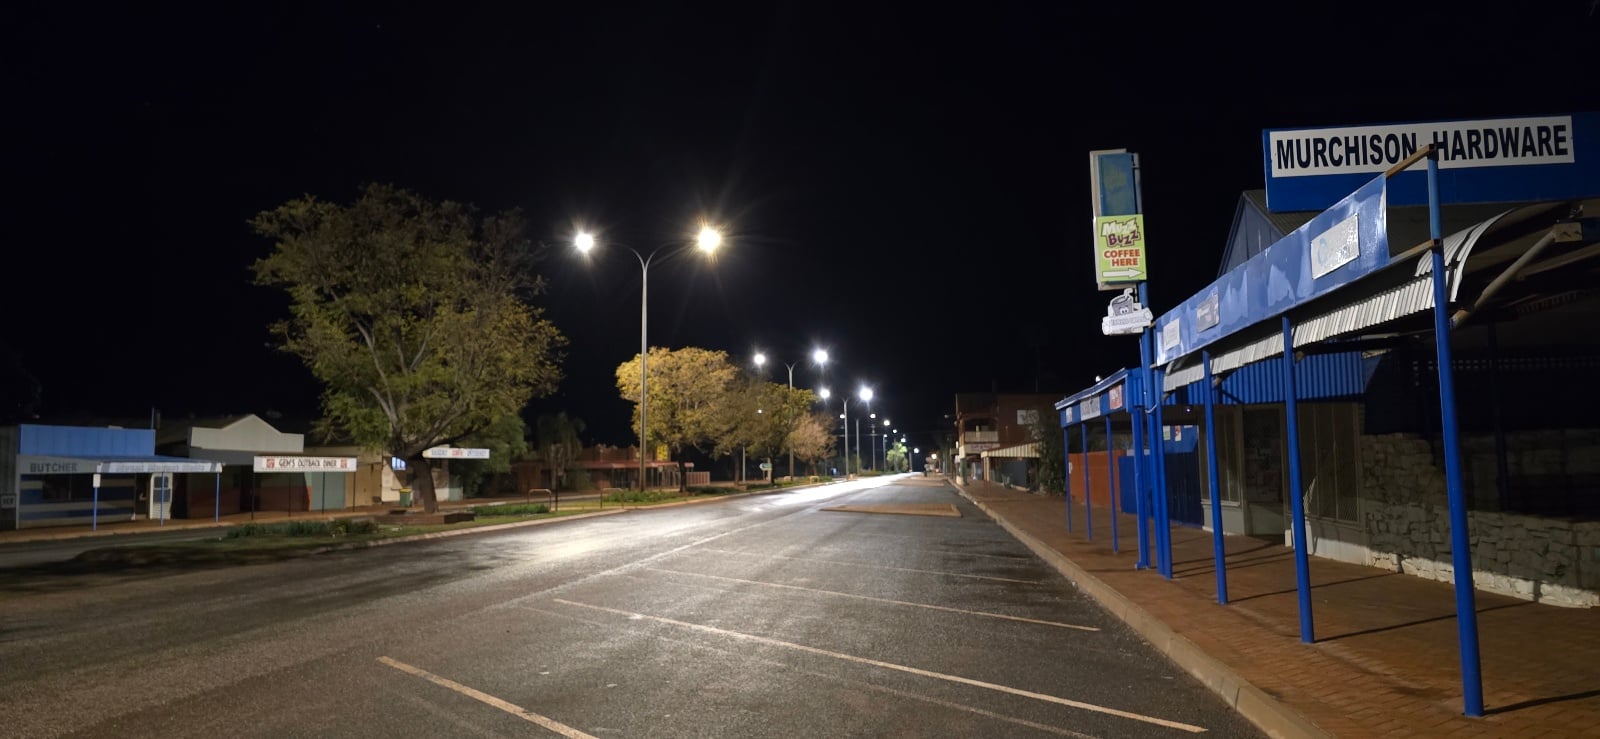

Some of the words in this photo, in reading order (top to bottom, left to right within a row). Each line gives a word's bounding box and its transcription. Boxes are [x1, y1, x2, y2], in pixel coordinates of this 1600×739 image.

[1276, 133, 1417, 169] MURCHISON
[1433, 125, 1568, 161] HARDWARE
[1104, 249, 1141, 258] COFFEE
[1112, 258, 1138, 267] HERE
[30, 463, 78, 473] BUTCHER
